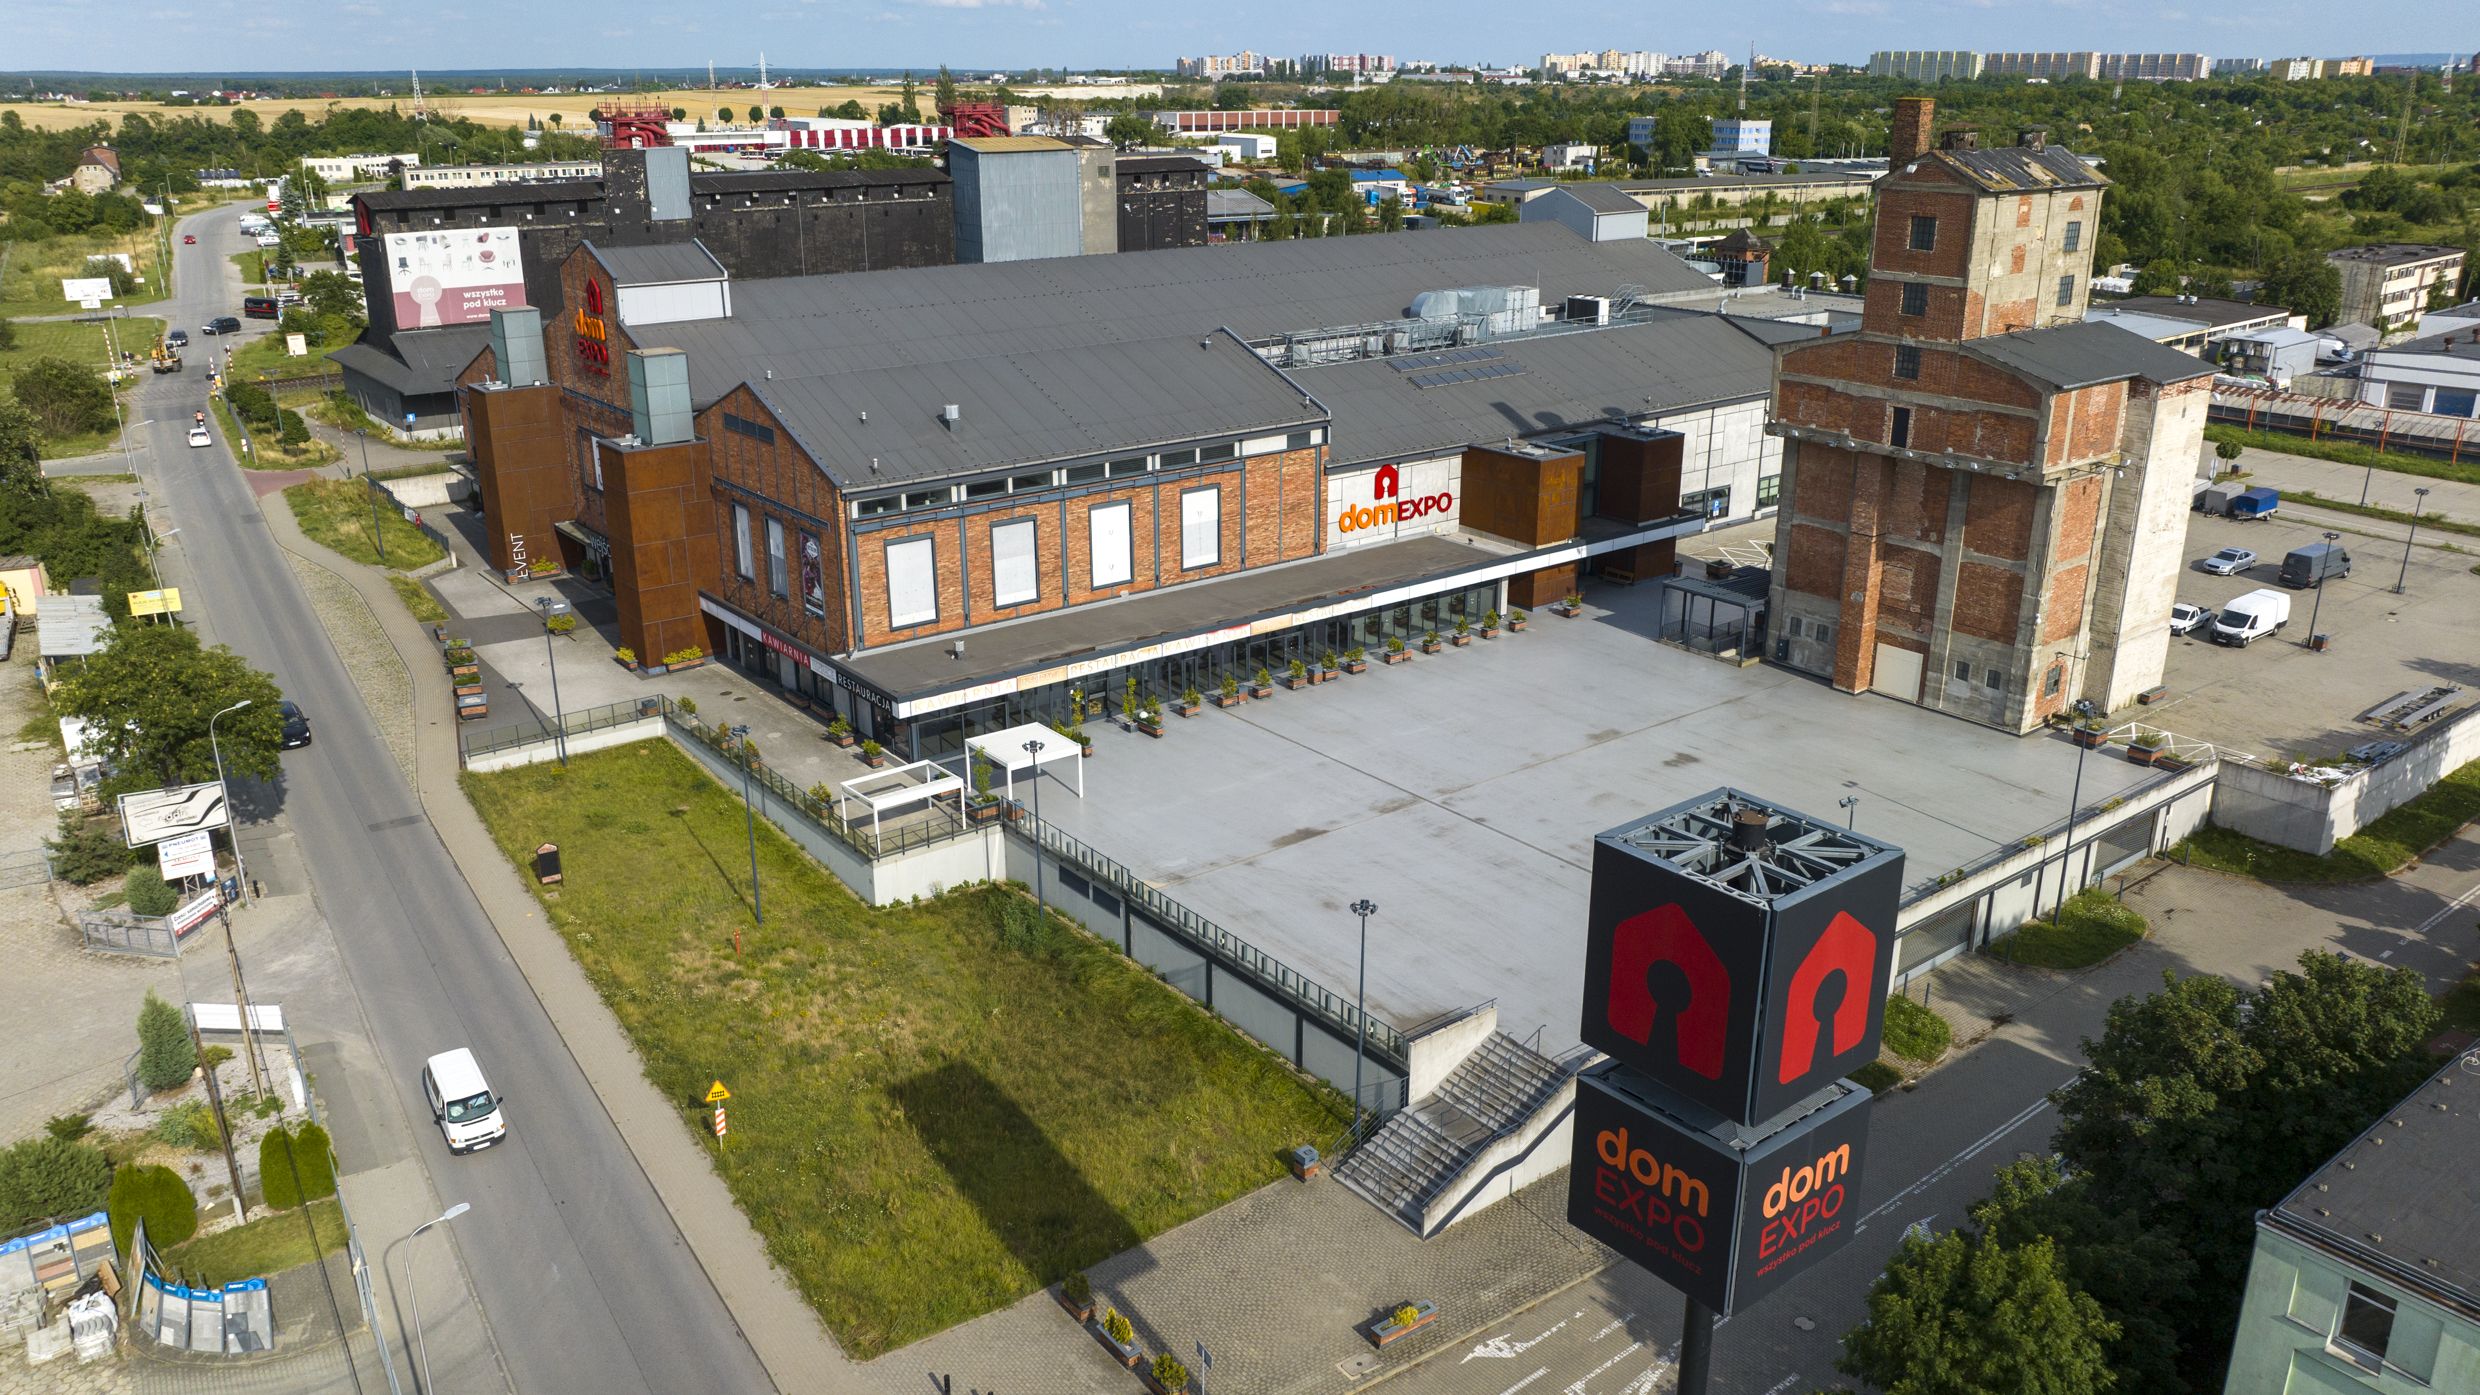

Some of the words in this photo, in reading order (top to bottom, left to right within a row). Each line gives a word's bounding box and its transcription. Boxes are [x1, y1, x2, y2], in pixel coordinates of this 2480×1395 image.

[463, 288, 504, 298] wszystko
[463, 300, 481, 310] pod
[483, 299, 507, 307] klucz
[576, 307, 606, 341] dom
[1339, 503, 1398, 533] dom
[1398, 492, 1453, 522] EXPO
[510, 533, 529, 578] EVENT
[762, 631, 809, 667] KAWIARNIA
[1070, 646, 1159, 677] RESTAURACJA
[838, 673, 891, 711] RESTAURACJA
[914, 681, 1013, 713] KAWIARNIA
[1596, 1127, 1710, 1217] dom
[1762, 1143, 1850, 1219] dom
[1595, 1166, 1705, 1253] EXPO
[1759, 1183, 1845, 1260] EXPO
[1757, 1246, 1798, 1278] wszystko
[1798, 1232, 1817, 1253] pod
[1817, 1220, 1841, 1240] klucz
